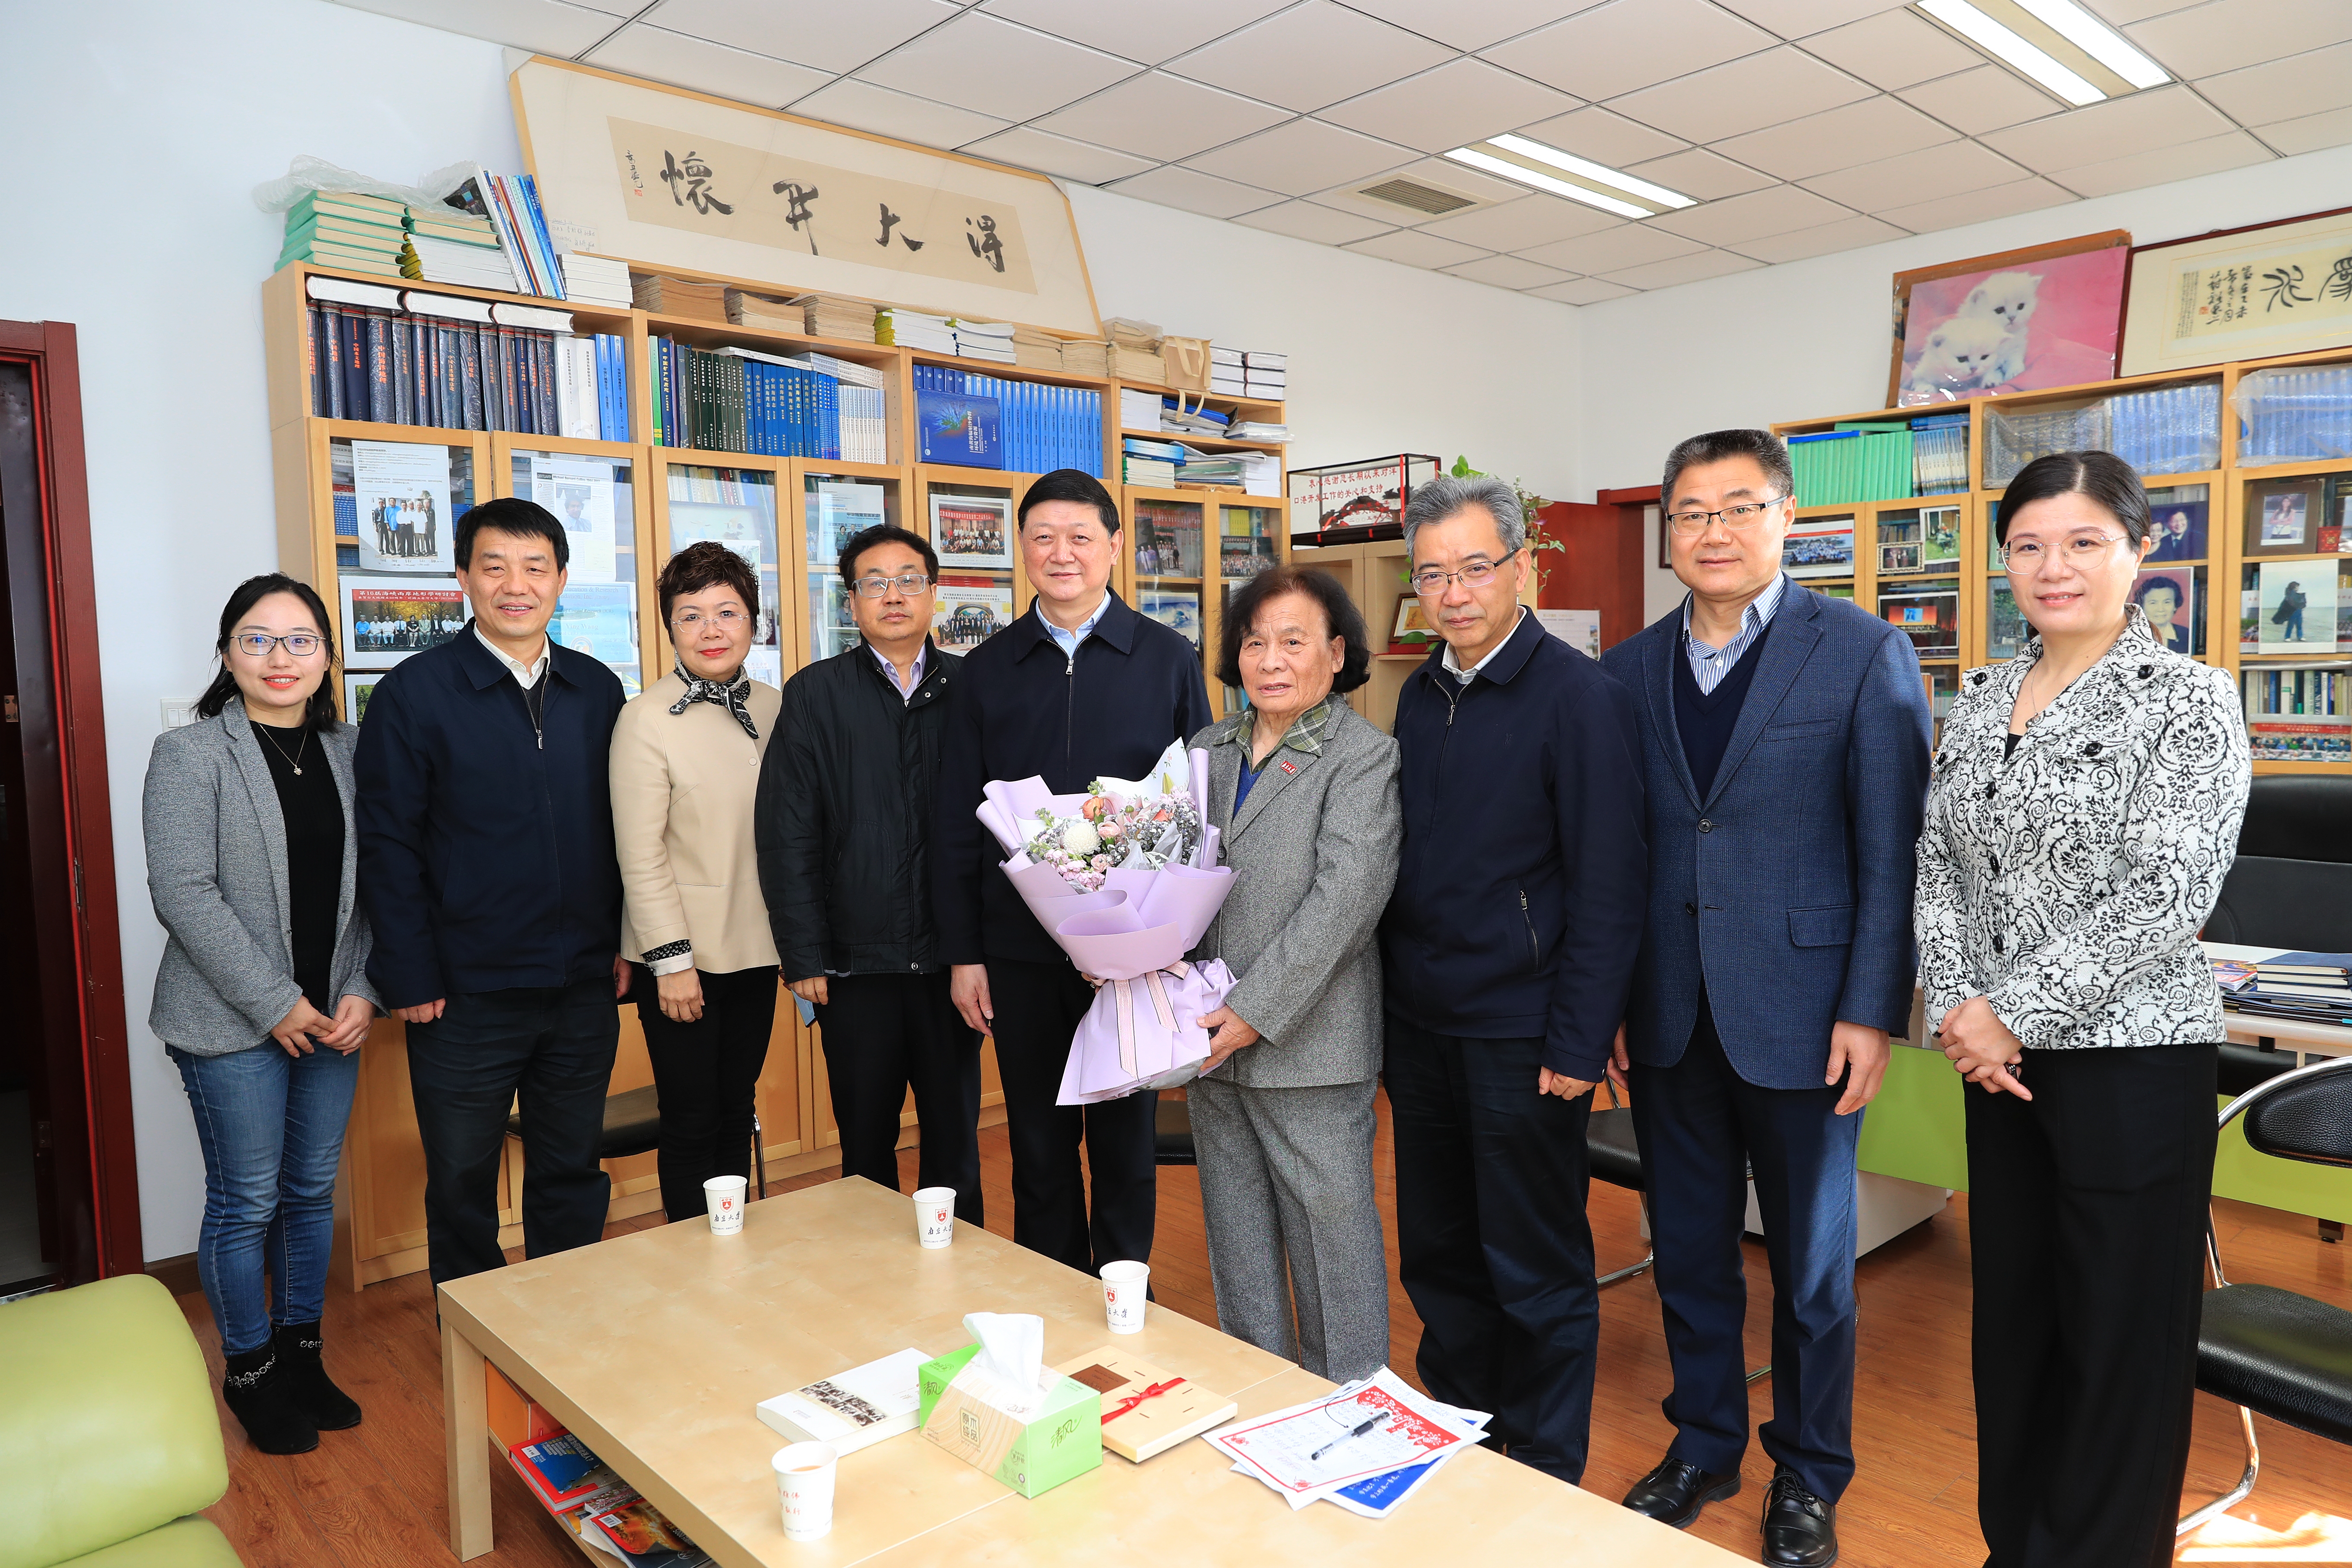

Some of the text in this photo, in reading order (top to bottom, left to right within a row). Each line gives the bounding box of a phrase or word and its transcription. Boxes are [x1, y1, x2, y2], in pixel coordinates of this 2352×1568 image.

[1309, 467, 1397, 488] 衷心感谢您长期以来对洋
[1294, 484, 1384, 504] 口港开发工作的关心和支持
[923, 1381, 943, 1396] 清风
[963, 1426, 977, 1442] 纯品
[1050, 1415, 1082, 1449] 清风
